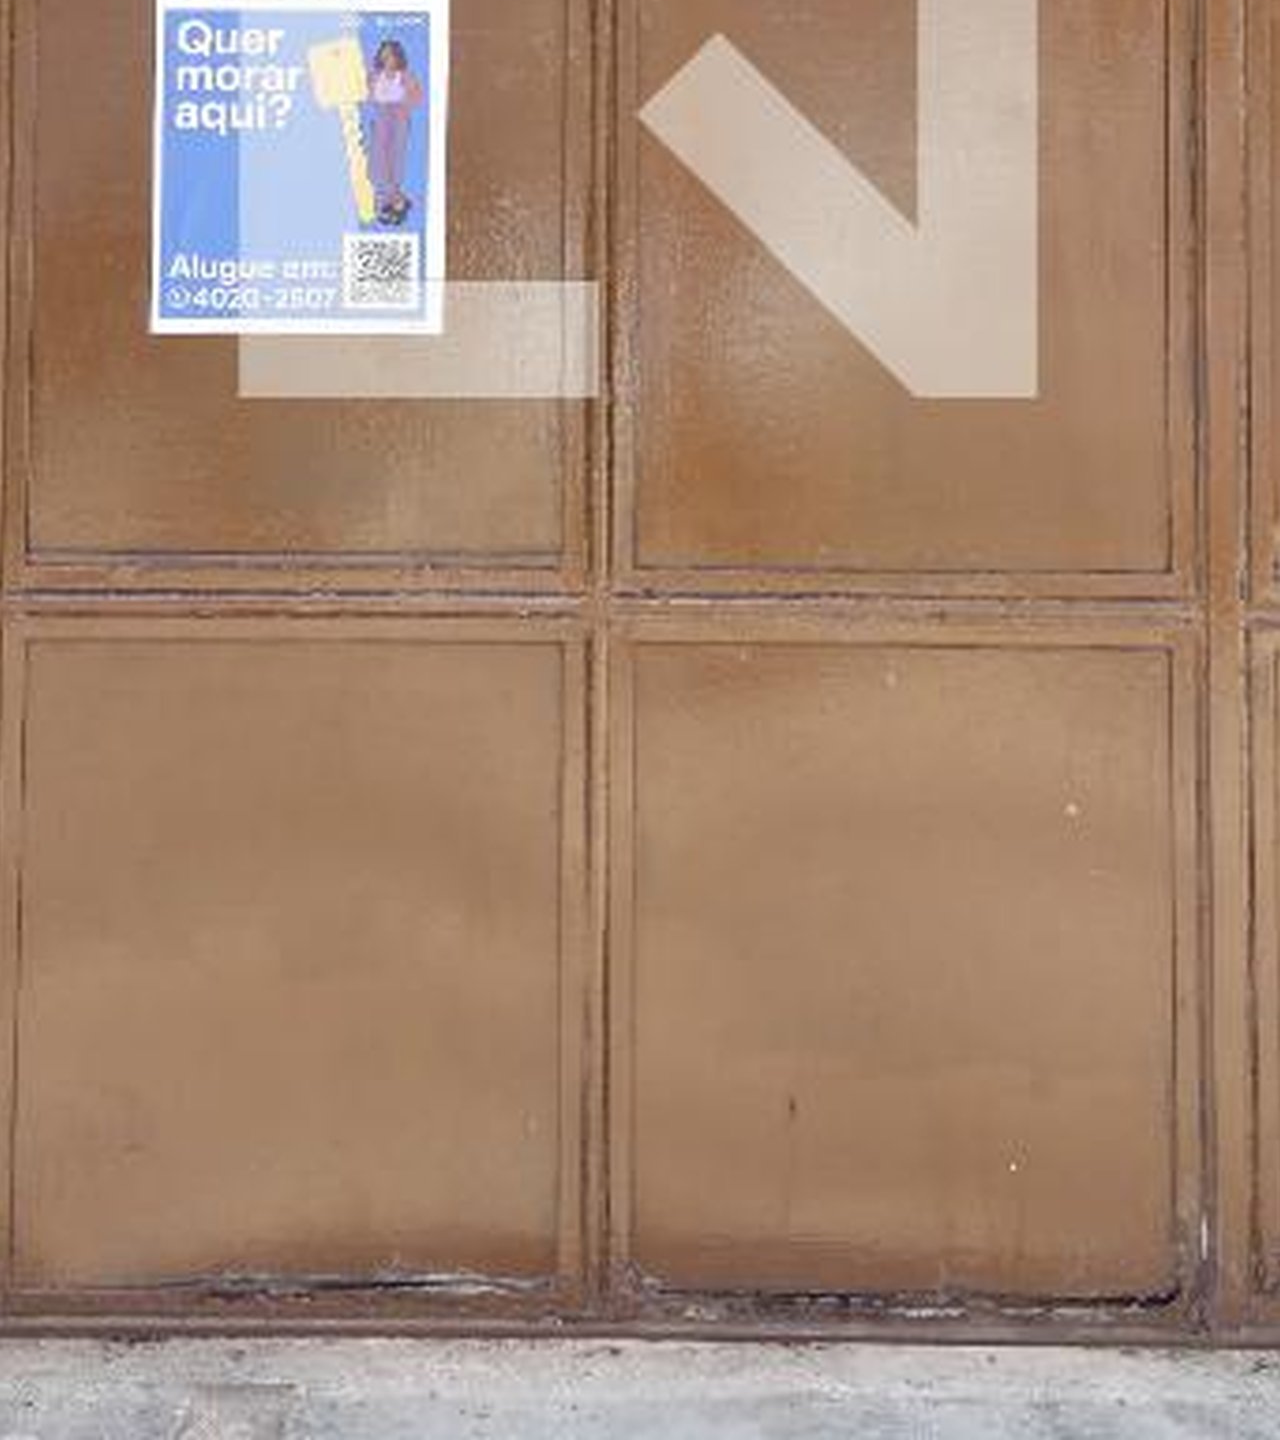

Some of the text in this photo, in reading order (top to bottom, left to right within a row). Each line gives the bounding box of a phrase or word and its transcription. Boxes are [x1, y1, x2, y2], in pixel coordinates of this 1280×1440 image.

[177, 20, 284, 58] Quer
[176, 61, 300, 91] morar
[174, 95, 292, 133] aqui?
[170, 255, 275, 286] Alugue
